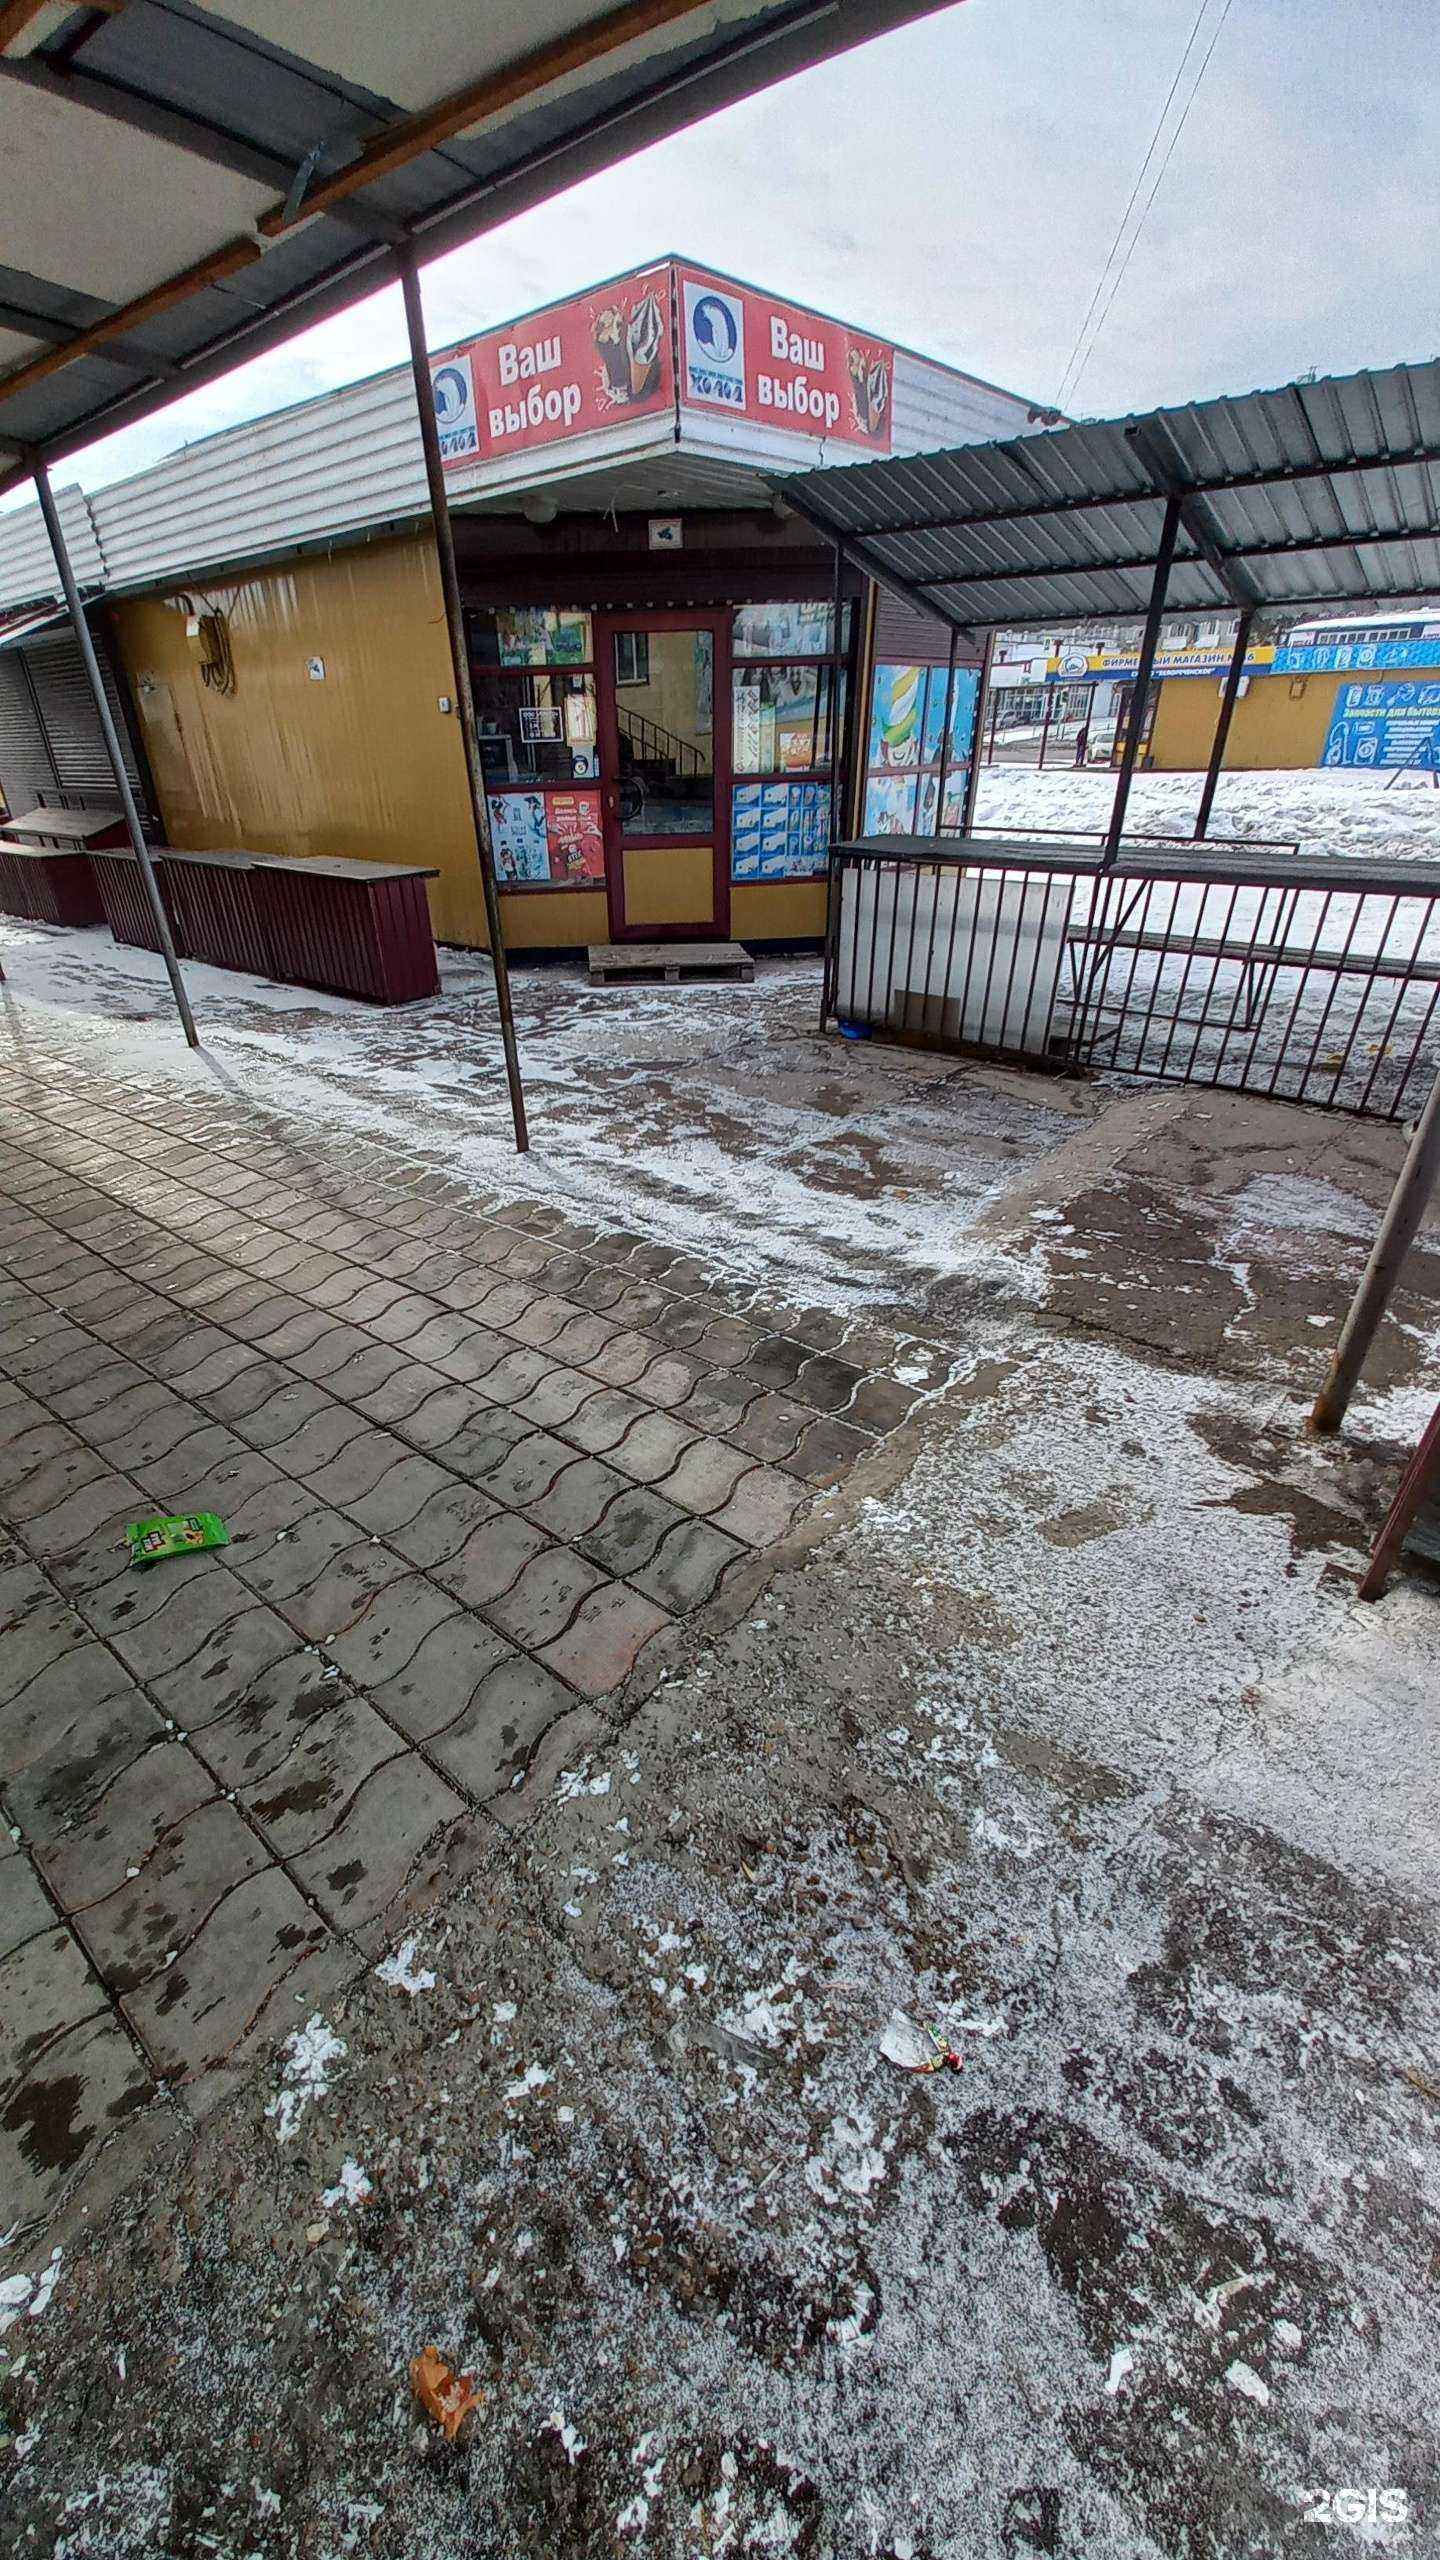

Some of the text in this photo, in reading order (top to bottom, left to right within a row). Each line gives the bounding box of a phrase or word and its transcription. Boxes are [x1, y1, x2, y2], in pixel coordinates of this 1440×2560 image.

[499, 336, 561, 386] Ваш
[771, 316, 824, 371] Ваш
[489, 384, 581, 438] выбор
[758, 374, 839, 428] выбор
[1102, 655, 1170, 667] ФИРМЕЫЙ
[1173, 654, 1224, 665] МАГАЗИН
